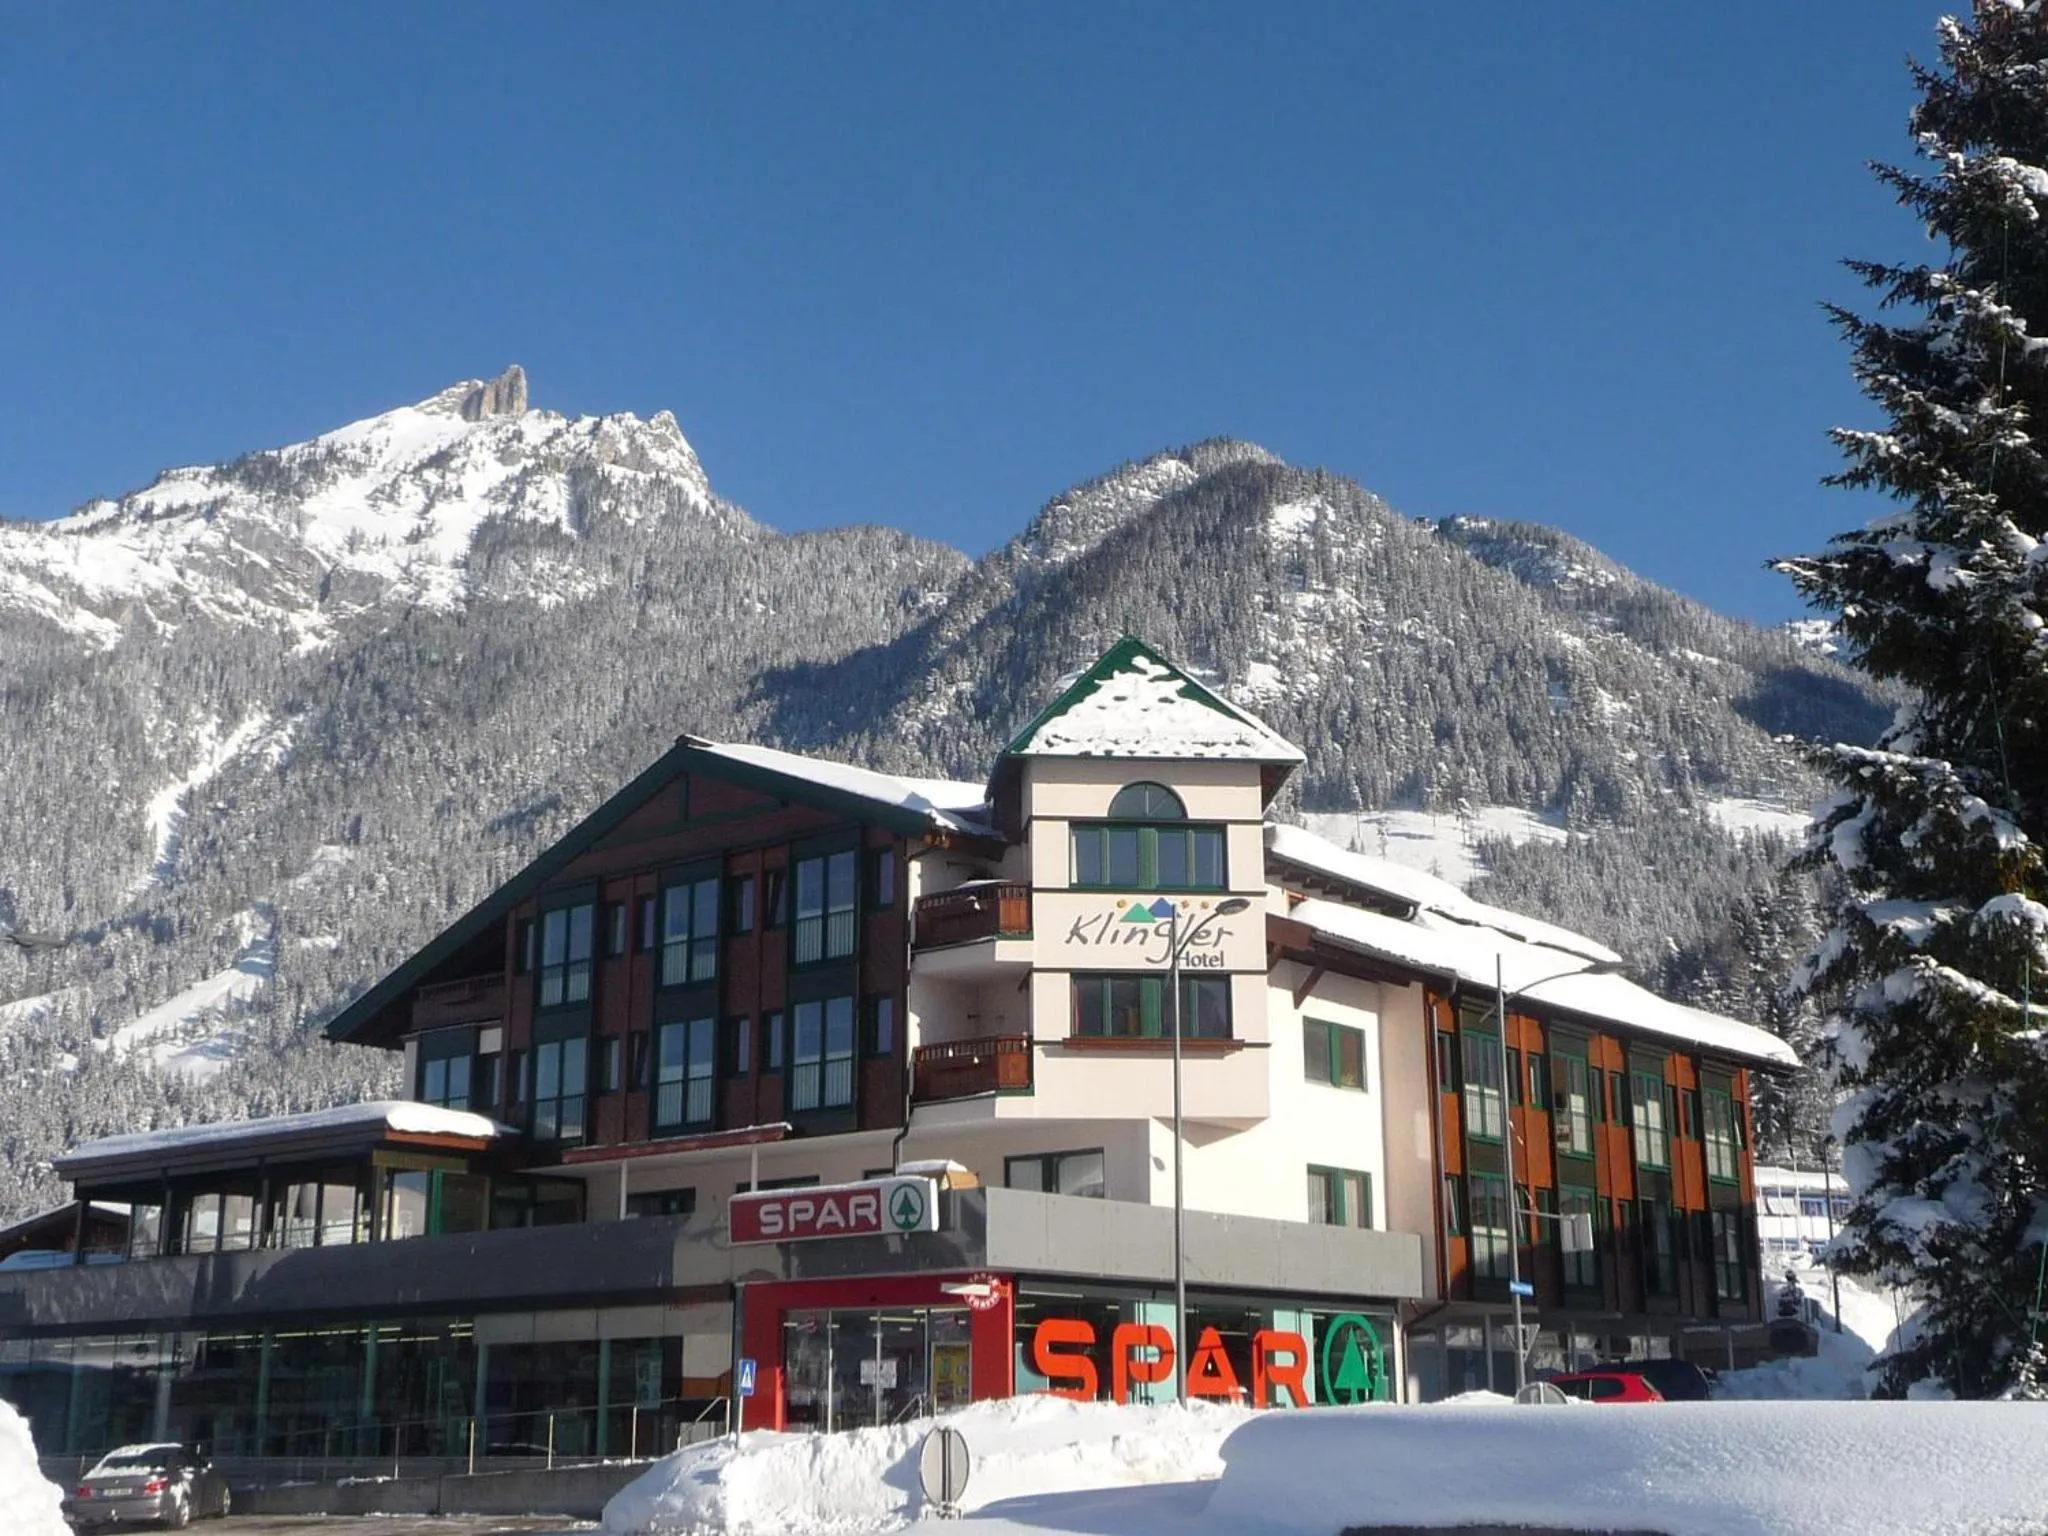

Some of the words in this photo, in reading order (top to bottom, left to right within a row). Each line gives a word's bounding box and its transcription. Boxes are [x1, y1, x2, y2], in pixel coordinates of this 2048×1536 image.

[1065, 911, 1233, 964] Klingler
[1177, 951, 1225, 967] Hotel
[759, 1195, 878, 1234] SPAR
[1034, 1317, 1309, 1408] SPAR
